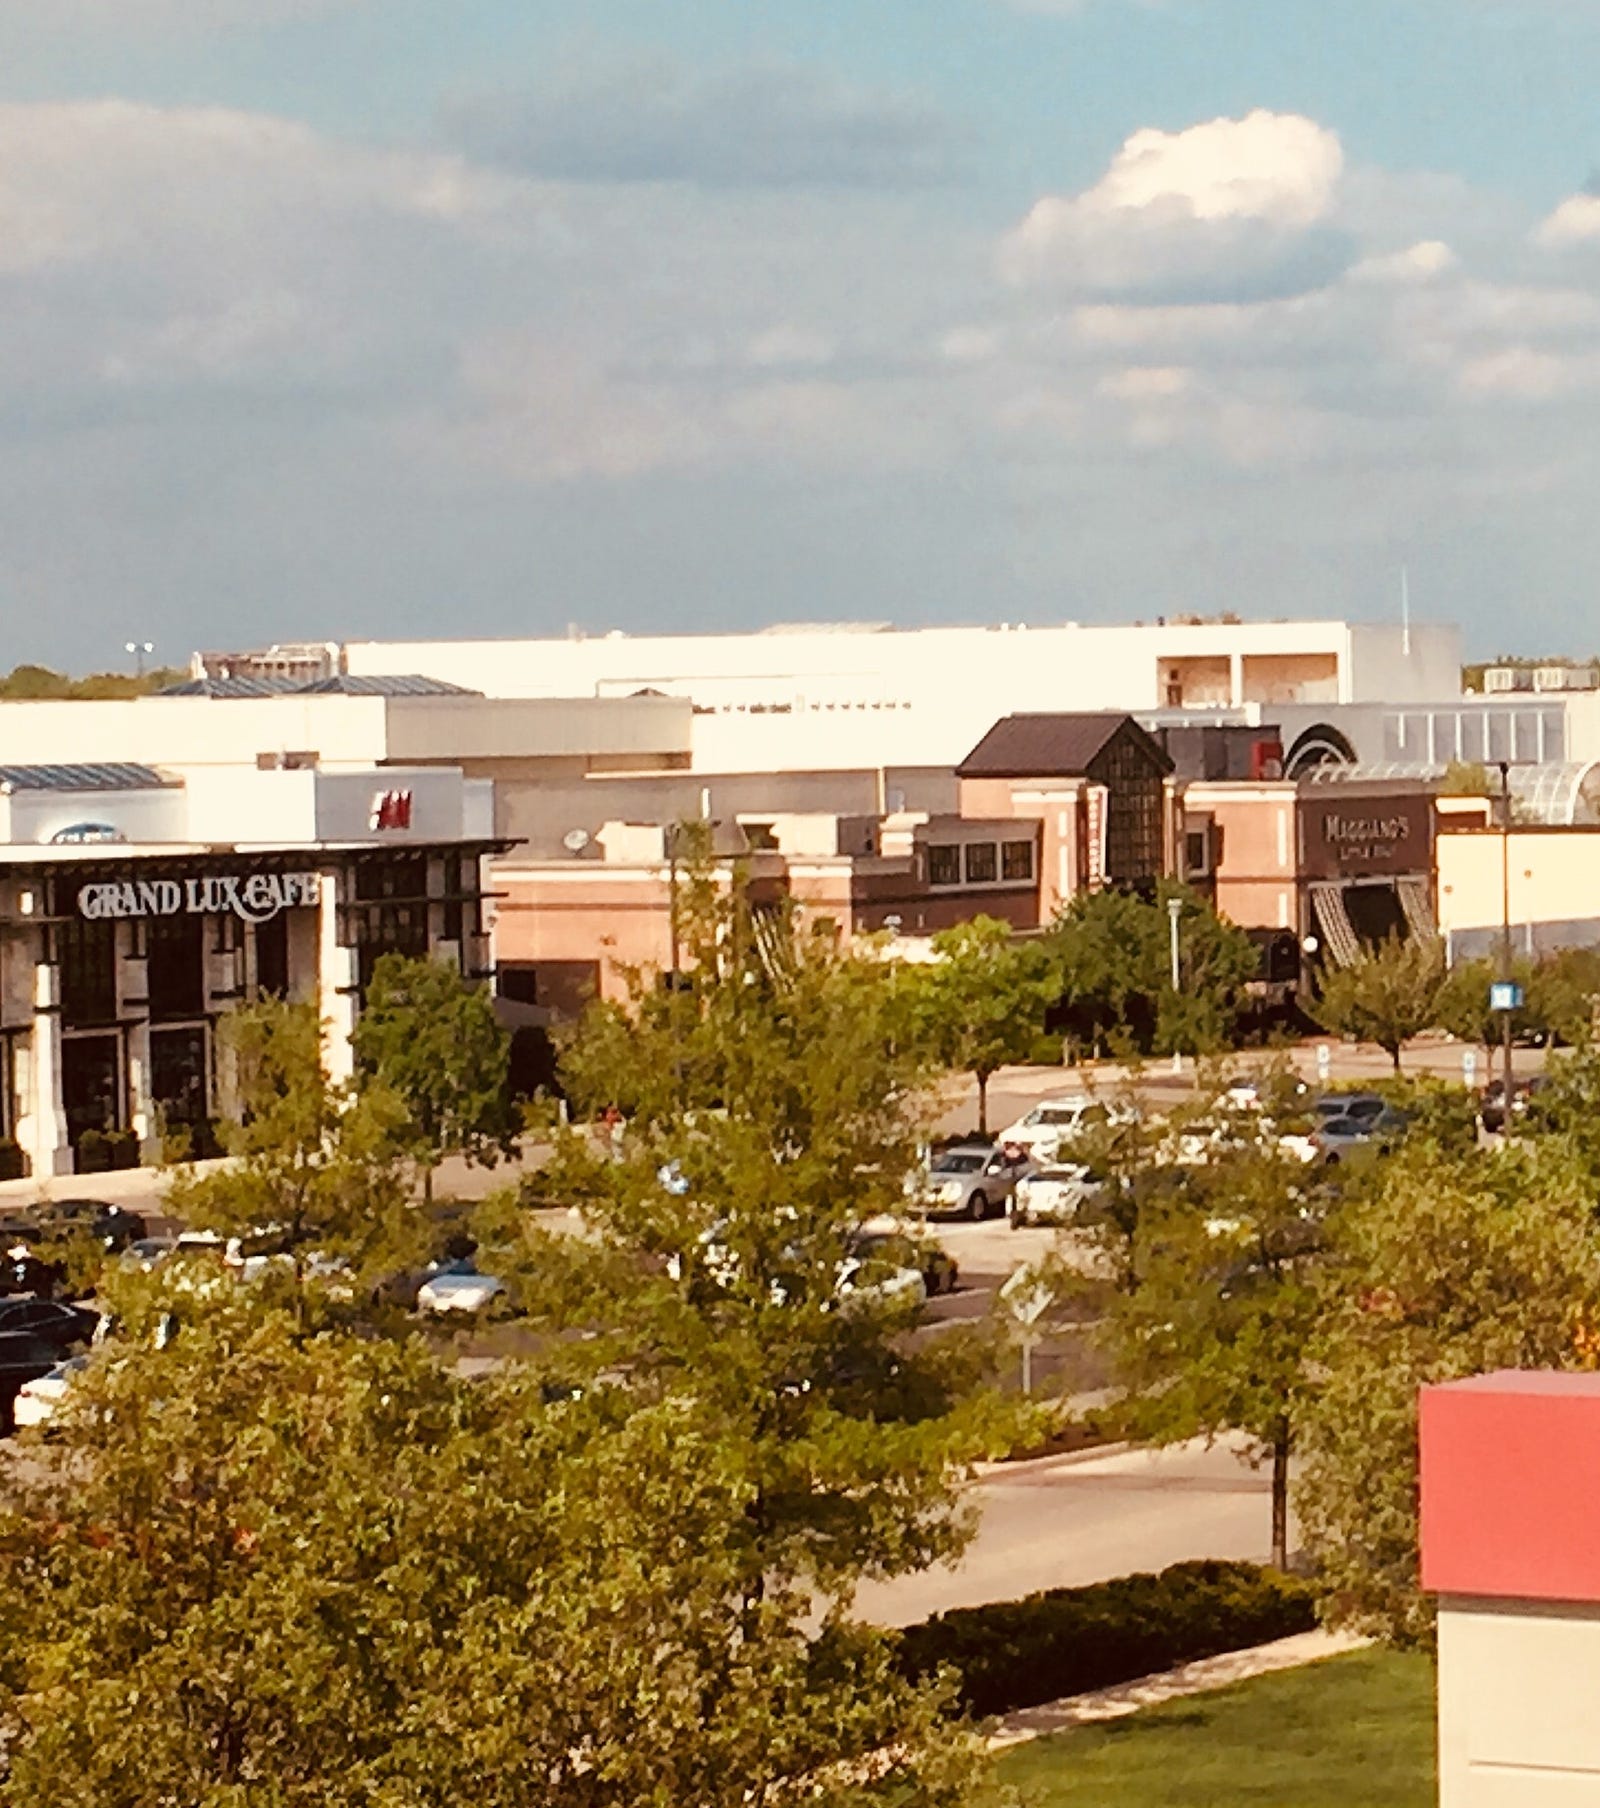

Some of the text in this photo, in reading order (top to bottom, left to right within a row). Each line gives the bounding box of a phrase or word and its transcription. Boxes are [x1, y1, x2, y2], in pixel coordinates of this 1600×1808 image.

[77, 872, 321, 922] GRAND LUX CAFE
